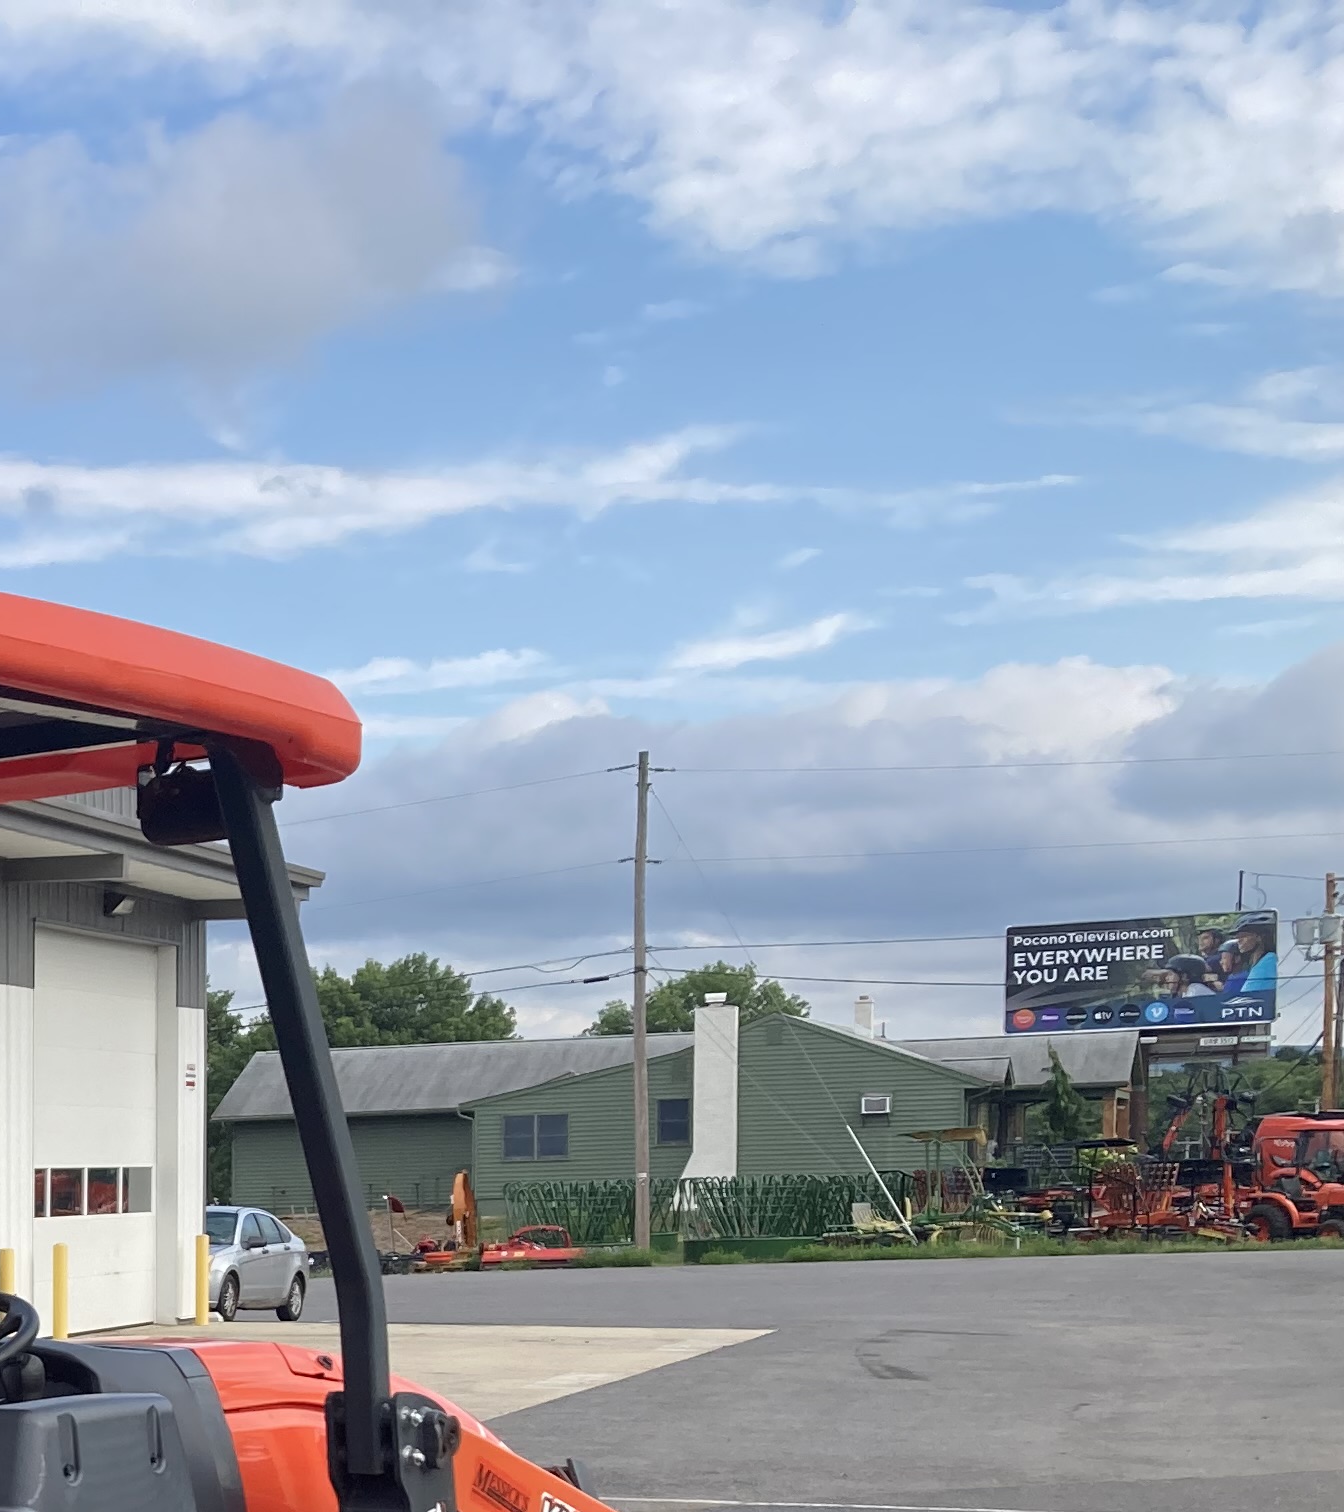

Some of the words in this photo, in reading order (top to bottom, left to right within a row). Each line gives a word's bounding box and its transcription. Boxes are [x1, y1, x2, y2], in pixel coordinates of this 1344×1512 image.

[1013, 928, 1174, 947] PoconoTelevision.com
[1014, 944, 1165, 968] EVERYWHERE
[1013, 967, 1058, 985] YOU
[1064, 965, 1109, 982] ARE
[1221, 1006, 1263, 1019] PTN
